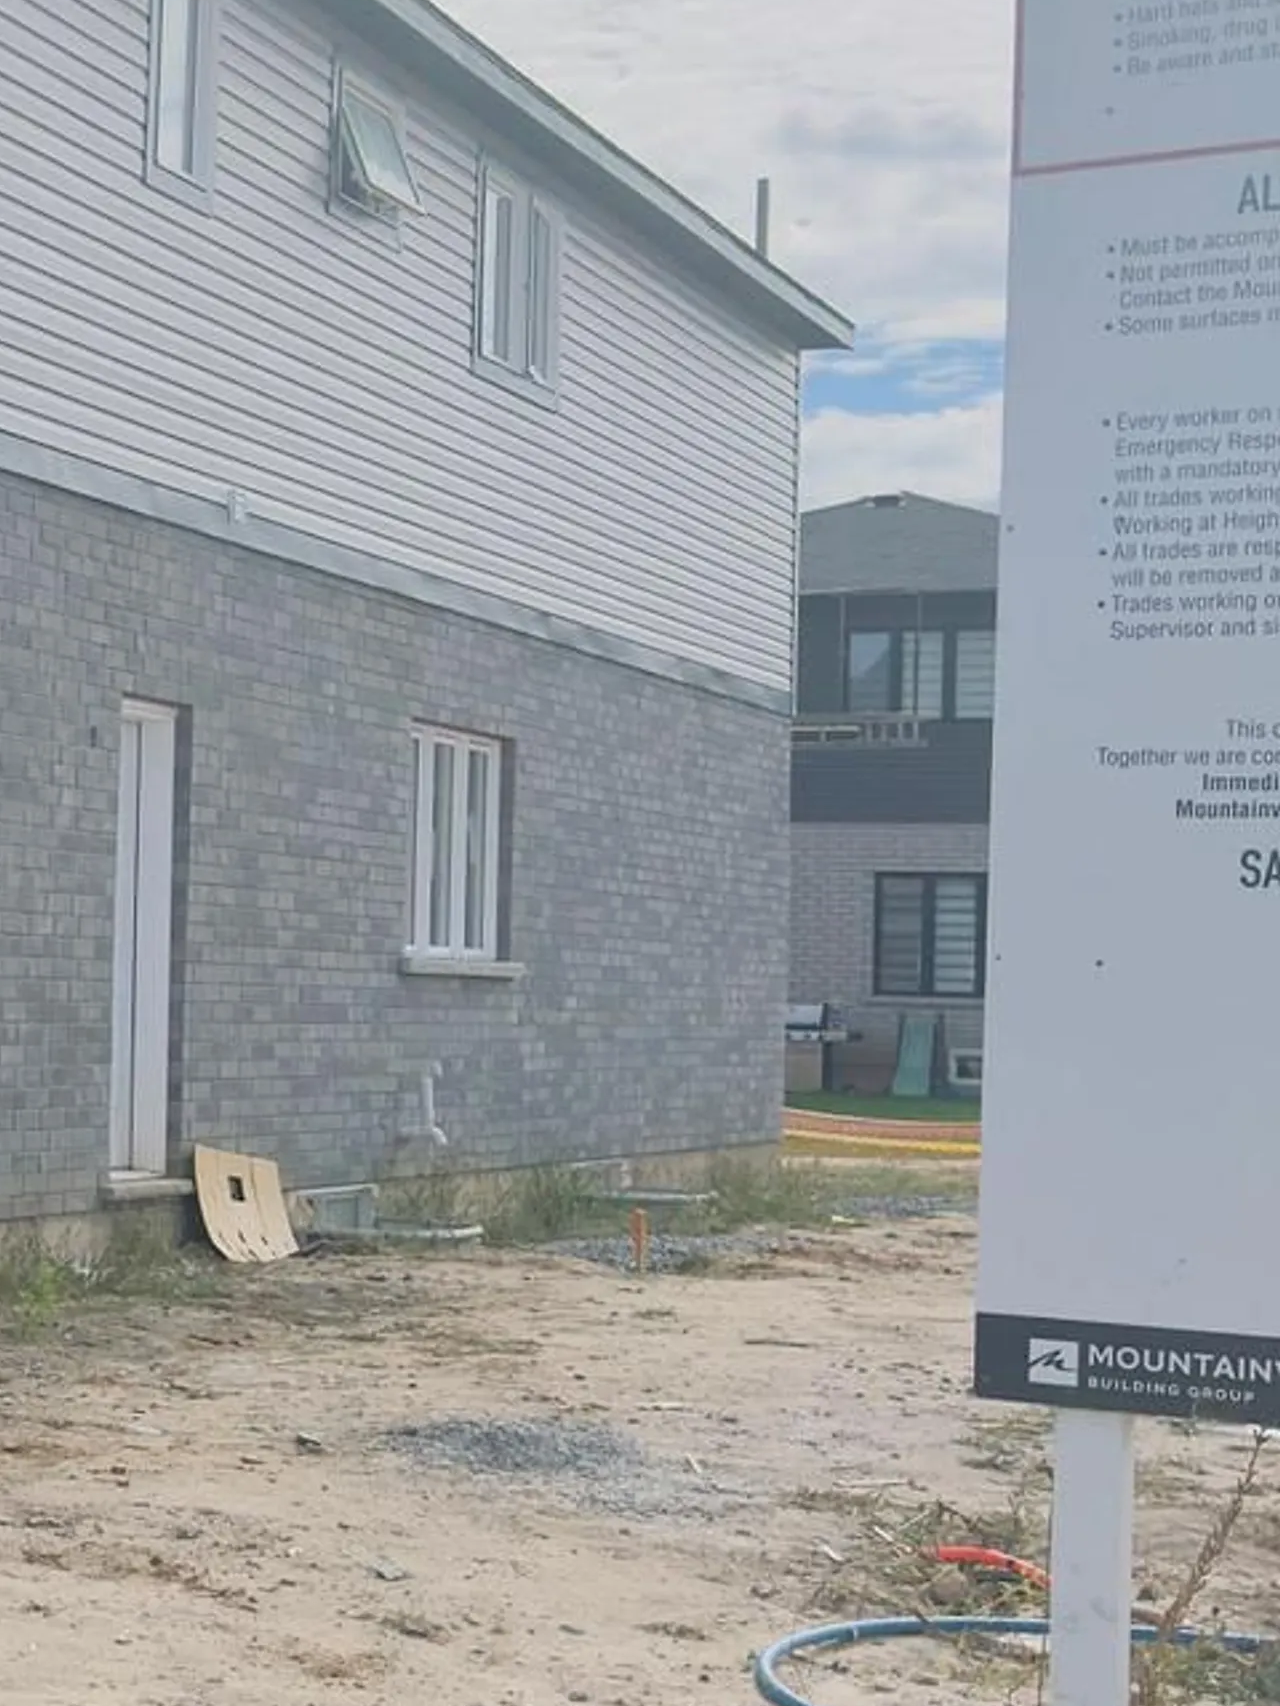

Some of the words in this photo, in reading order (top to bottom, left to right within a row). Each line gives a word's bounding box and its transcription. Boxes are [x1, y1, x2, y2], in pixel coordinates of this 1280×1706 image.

[1175, 234, 1197, 253] be
[1120, 287, 1191, 310] Contact
[1197, 284, 1228, 301] the
[1116, 411, 1168, 433] Every
[1173, 407, 1241, 427] worker
[1247, 407, 1271, 423] on
[1115, 435, 1221, 458] Emergency
[1115, 464, 1154, 483] with
[1113, 491, 1138, 508] All
[1144, 487, 1202, 507] trades
[1113, 515, 1193, 536] Working
[1198, 514, 1216, 531] at
[1111, 541, 1137, 560] All
[1142, 540, 1201, 559] trades
[1208, 542, 1237, 558] are
[1111, 569, 1143, 587] will
[1150, 568, 1172, 586] be
[1179, 564, 1263, 584] removed
[1112, 594, 1173, 613] Trades
[1179, 592, 1257, 612] working
[1110, 619, 1213, 640] Supervisor
[1221, 617, 1256, 636] and
[1226, 719, 1266, 739] This
[1098, 746, 1177, 768] Together
[1183, 750, 1210, 765] we
[1216, 749, 1246, 765] are
[1088, 1377, 1180, 1397] BUILDING
[1187, 1386, 1256, 1402] GROUP
